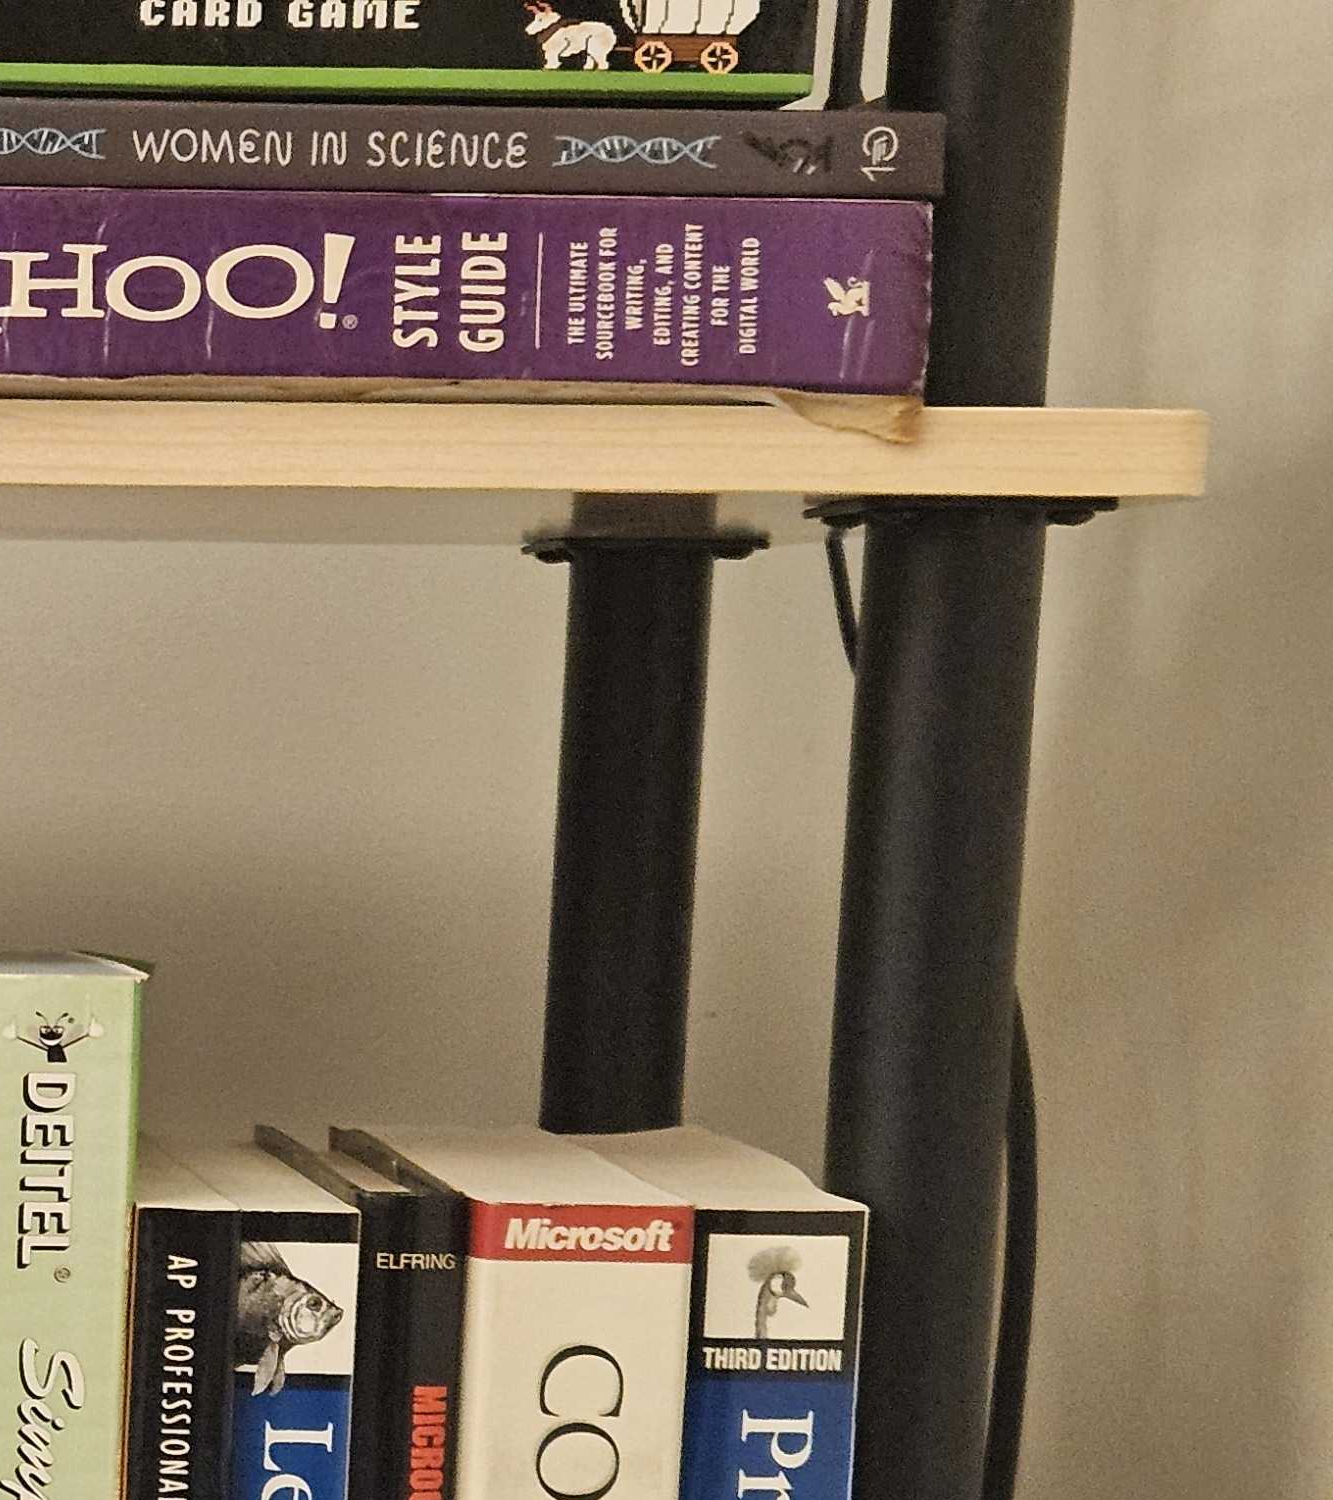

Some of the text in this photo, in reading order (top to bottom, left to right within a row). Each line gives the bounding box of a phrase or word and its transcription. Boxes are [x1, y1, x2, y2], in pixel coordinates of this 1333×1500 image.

[133, 129, 528, 169] WOMEN IN SCIENCE
[393, 235, 441, 347] STYLE
[459, 232, 507, 352] GUIDE
[568, 242, 588, 344] THE ULTIMATE
[595, 228, 617, 359] SOURCEBOOK FOR
[625, 259, 647, 329] WRITING,
[653, 244, 674, 345] EDITING, AND
[681, 224, 703, 366] CREATING CONTENT
[710, 266, 730, 325] FOR THE
[739, 238, 760, 354] DIGITAL WORLD
[167, 1255, 198, 1288] AP
[377, 1253, 455, 1269] ELFRING
[505, 1218, 674, 1251] Microsoft
[703, 1347, 842, 1371] THIRD EDITION
